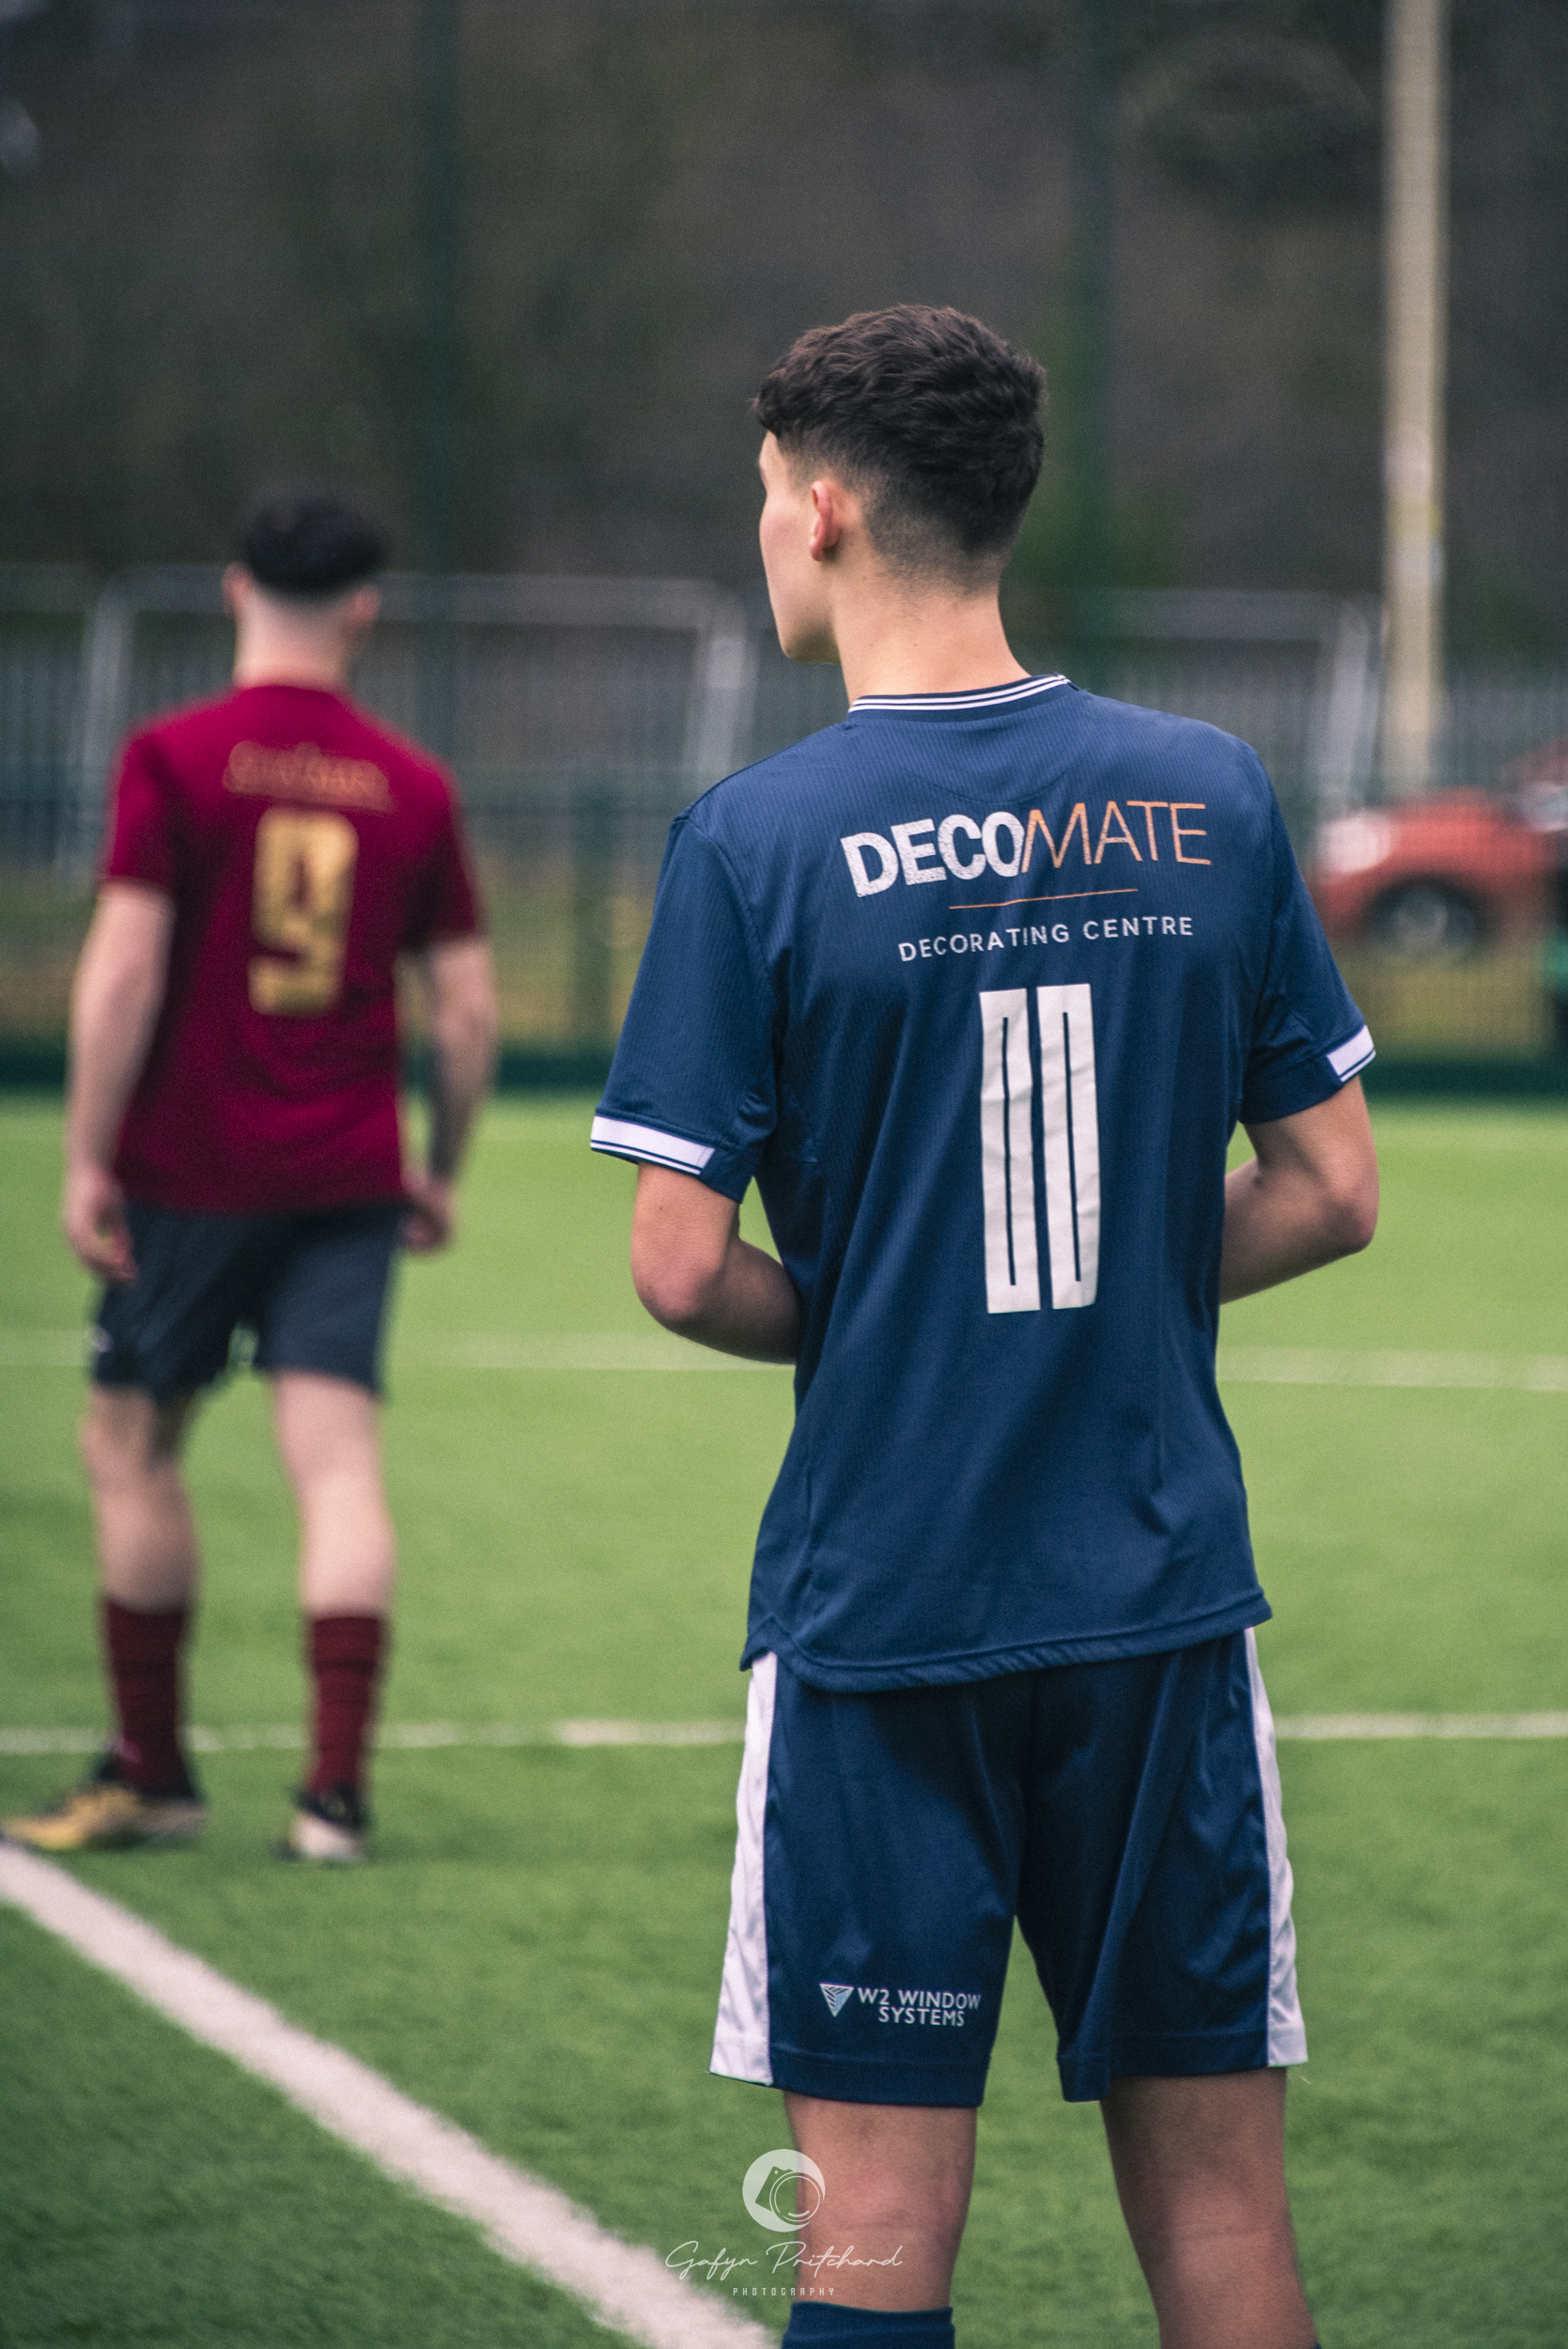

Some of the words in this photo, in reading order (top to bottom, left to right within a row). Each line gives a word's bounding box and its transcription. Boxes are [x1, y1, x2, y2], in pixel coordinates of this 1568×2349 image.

[840, 801, 1212, 897] DECOMATE
[248, 808, 359, 1016] 9
[898, 924, 1070, 962] DECORATING
[1082, 916, 1194, 941] CENTRE
[979, 983, 1100, 1314] 11
[857, 1987, 890, 2005] W2
[897, 1989, 982, 2010] WINDOW
[878, 2006, 966, 2027] SYSTEMS
